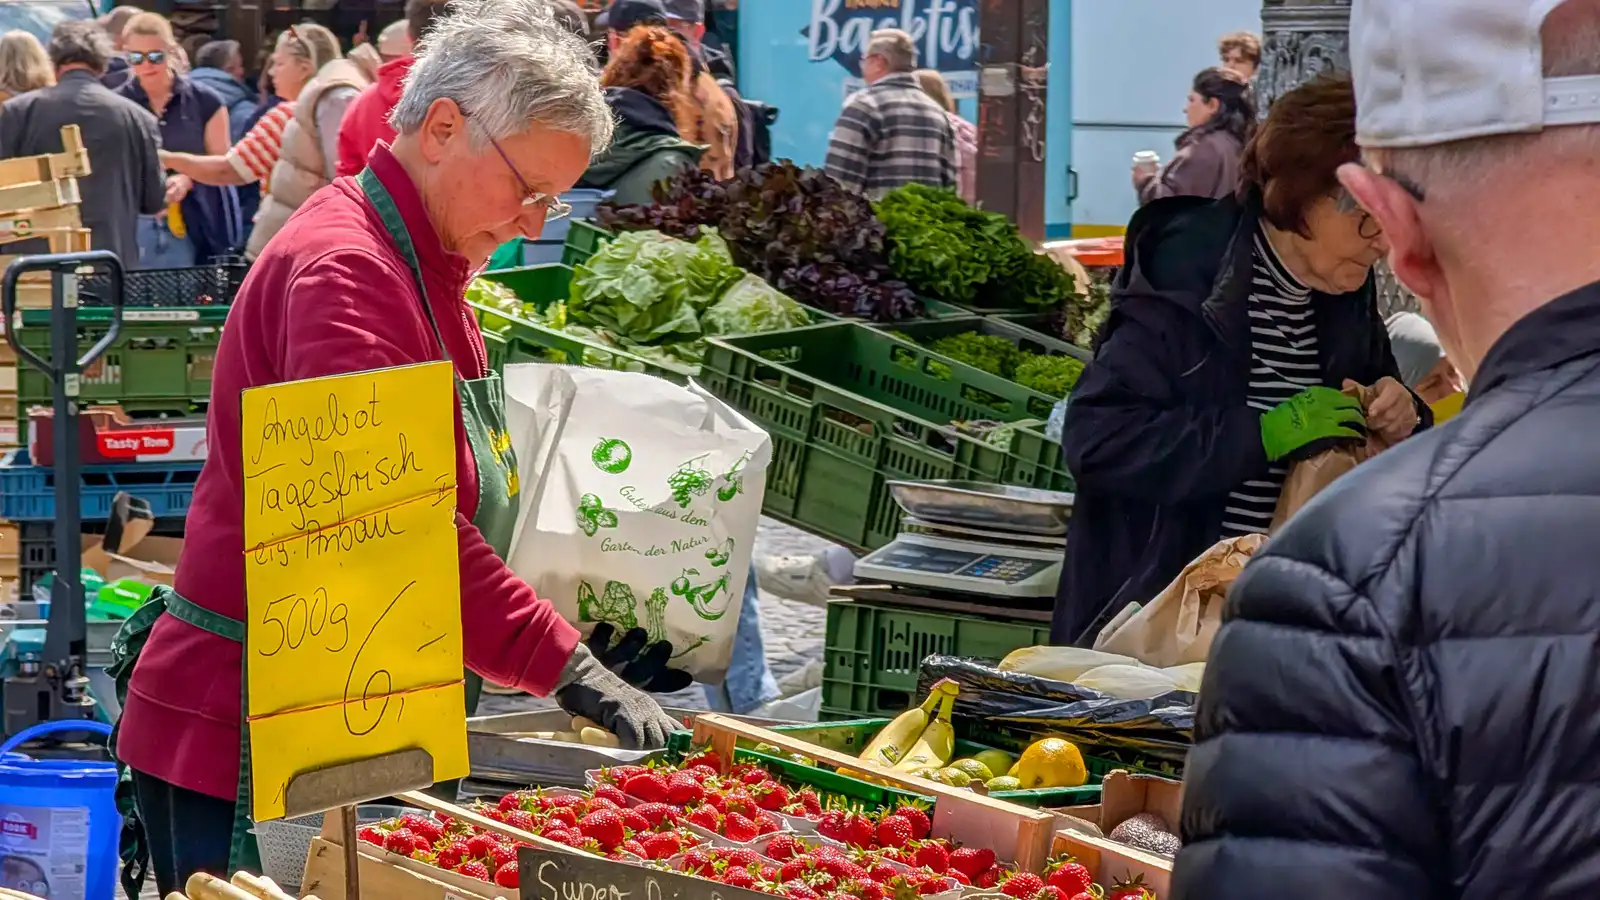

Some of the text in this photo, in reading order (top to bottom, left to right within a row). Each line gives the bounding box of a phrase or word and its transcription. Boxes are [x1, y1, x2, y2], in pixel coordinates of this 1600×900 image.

[104, 437, 140, 450] Tasty
[252, 382, 382, 465] Angebot
[246, 432, 423, 531] Tagesfrisch
[619, 485, 708, 527] Gutes aus dem
[305, 511, 405, 559] Anbau
[601, 535, 711, 557] Garten der Natur
[258, 587, 349, 656] 500g
